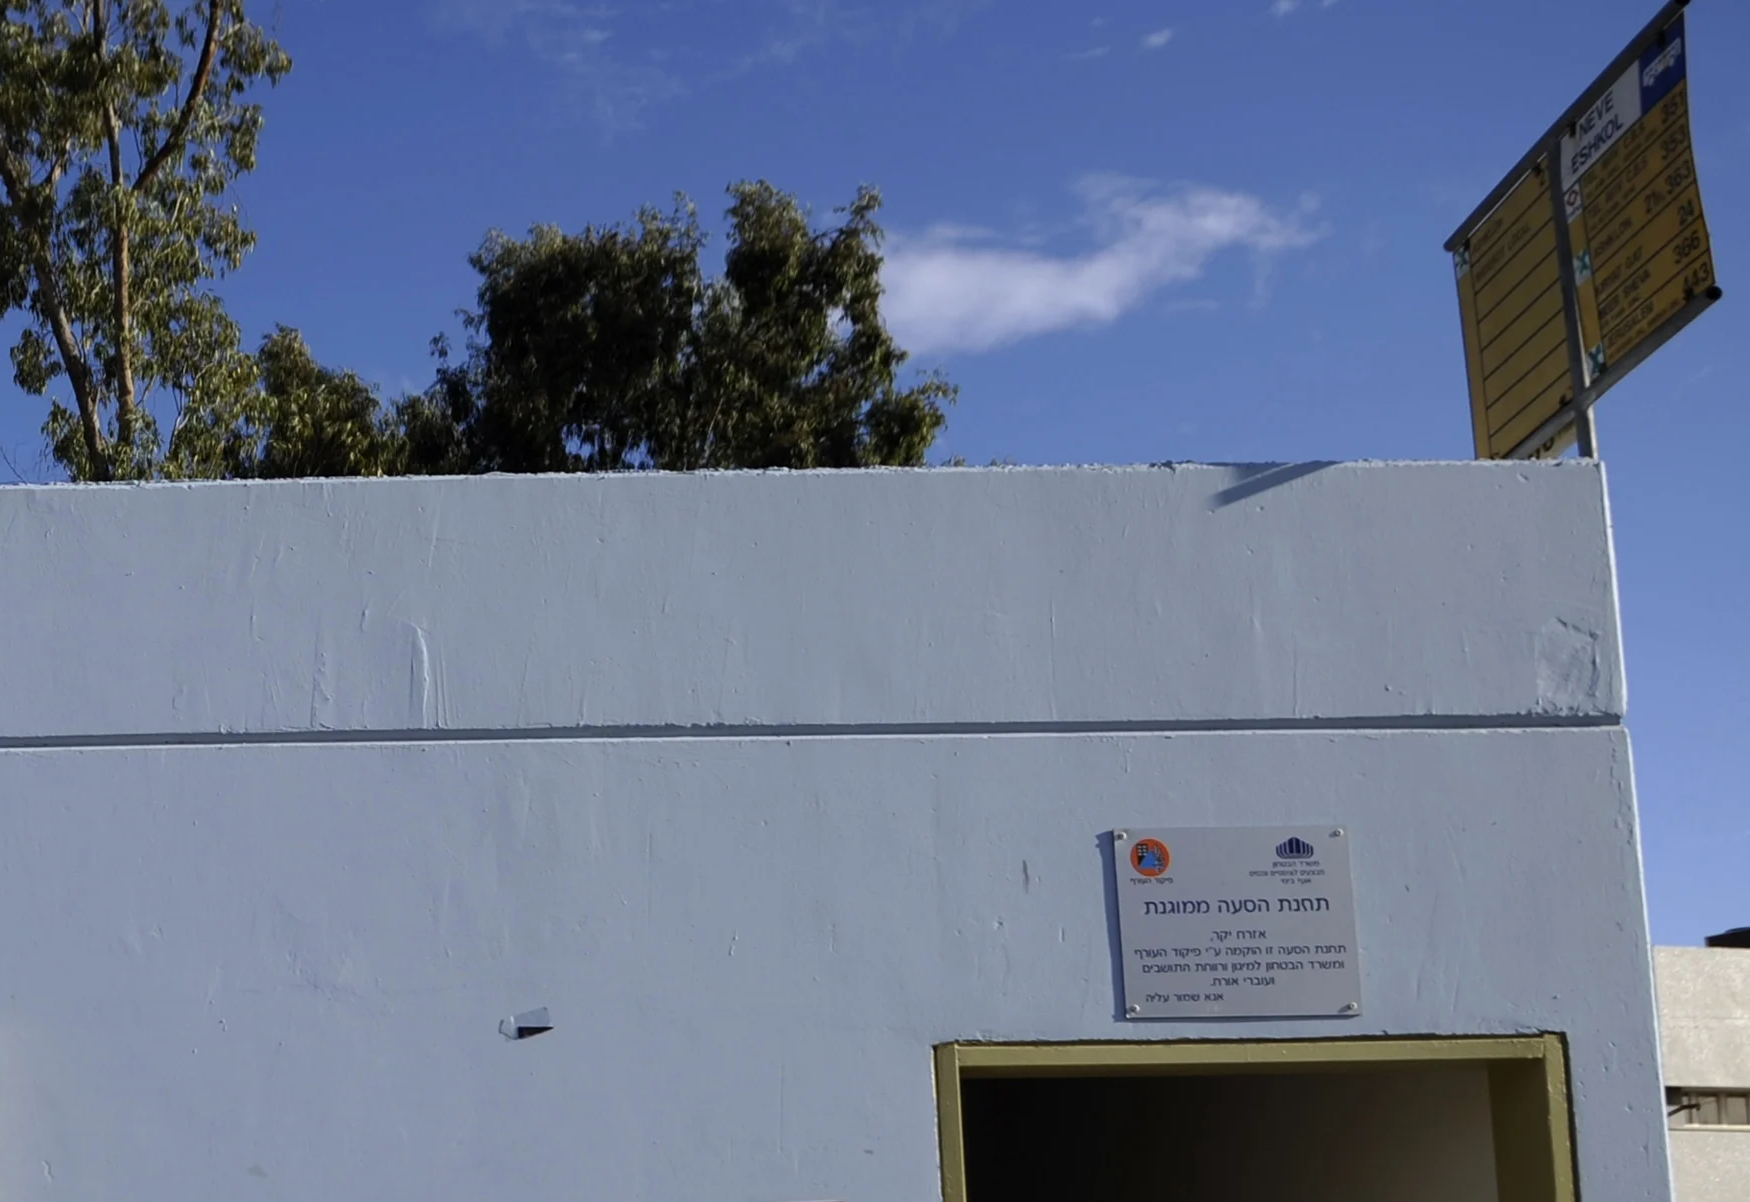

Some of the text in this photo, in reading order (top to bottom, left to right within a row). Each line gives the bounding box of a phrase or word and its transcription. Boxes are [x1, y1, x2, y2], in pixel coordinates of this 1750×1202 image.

[1579, 89, 1614, 139] NEVE
[1570, 114, 1624, 174] ESHKOL
[1662, 124, 1686, 160] 353
[1667, 159, 1691, 195] 363
[1678, 199, 1695, 226] 24
[1673, 230, 1701, 264] 366
[1144, 897, 1329, 915] תחנת הסעה ממוגנת
[1210, 930, 1266, 942] אזרח יקר,
[1134, 949, 1166, 958] העורף
[1172, 948, 1201, 958] פיקוד
[1226, 947, 1261, 957] הוקמה
[1266, 947, 1273, 955] זו
[1278, 946, 1310, 956] הסעה
[1315, 945, 1347, 954] תחנת
[1143, 964, 1191, 974] התושבים
[1231, 961, 1261, 973] למיגון
[1266, 962, 1303, 972] הבטחון
[1308, 961, 1344, 969] ומשרד
[1243, 977, 1275, 986] ועוברי
[1146, 993, 1224, 1004] אנא שמור עליה
